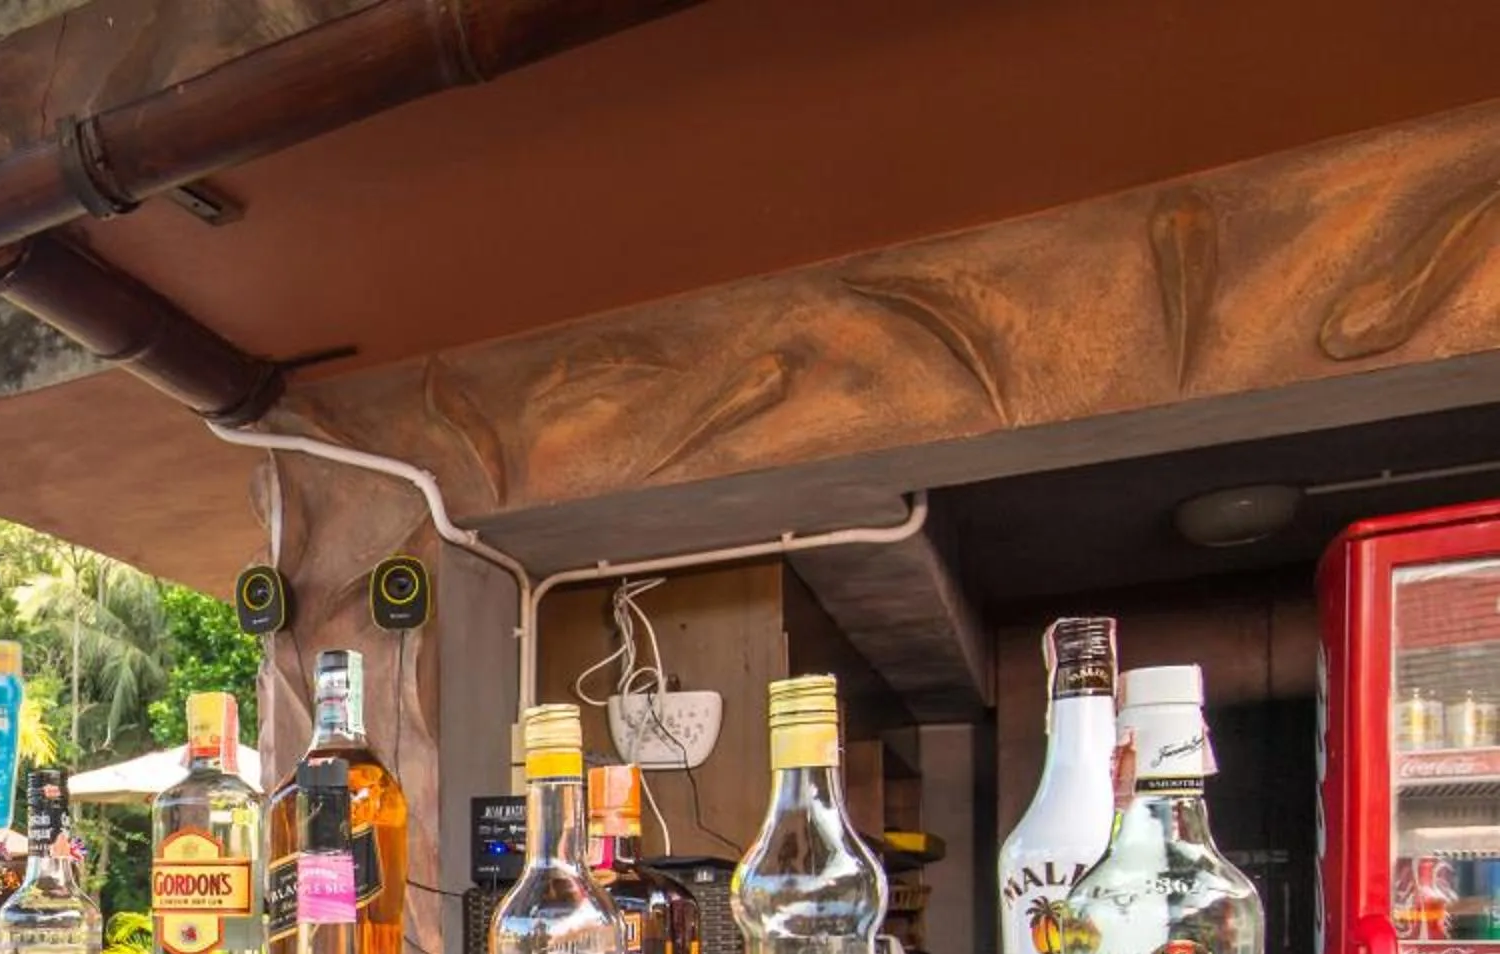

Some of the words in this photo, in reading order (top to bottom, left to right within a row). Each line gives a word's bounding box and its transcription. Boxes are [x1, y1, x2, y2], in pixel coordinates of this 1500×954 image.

[154, 872, 233, 896] GORDON'S
[271, 880, 298, 903] BLAC
[1004, 861, 1087, 909] MALI
